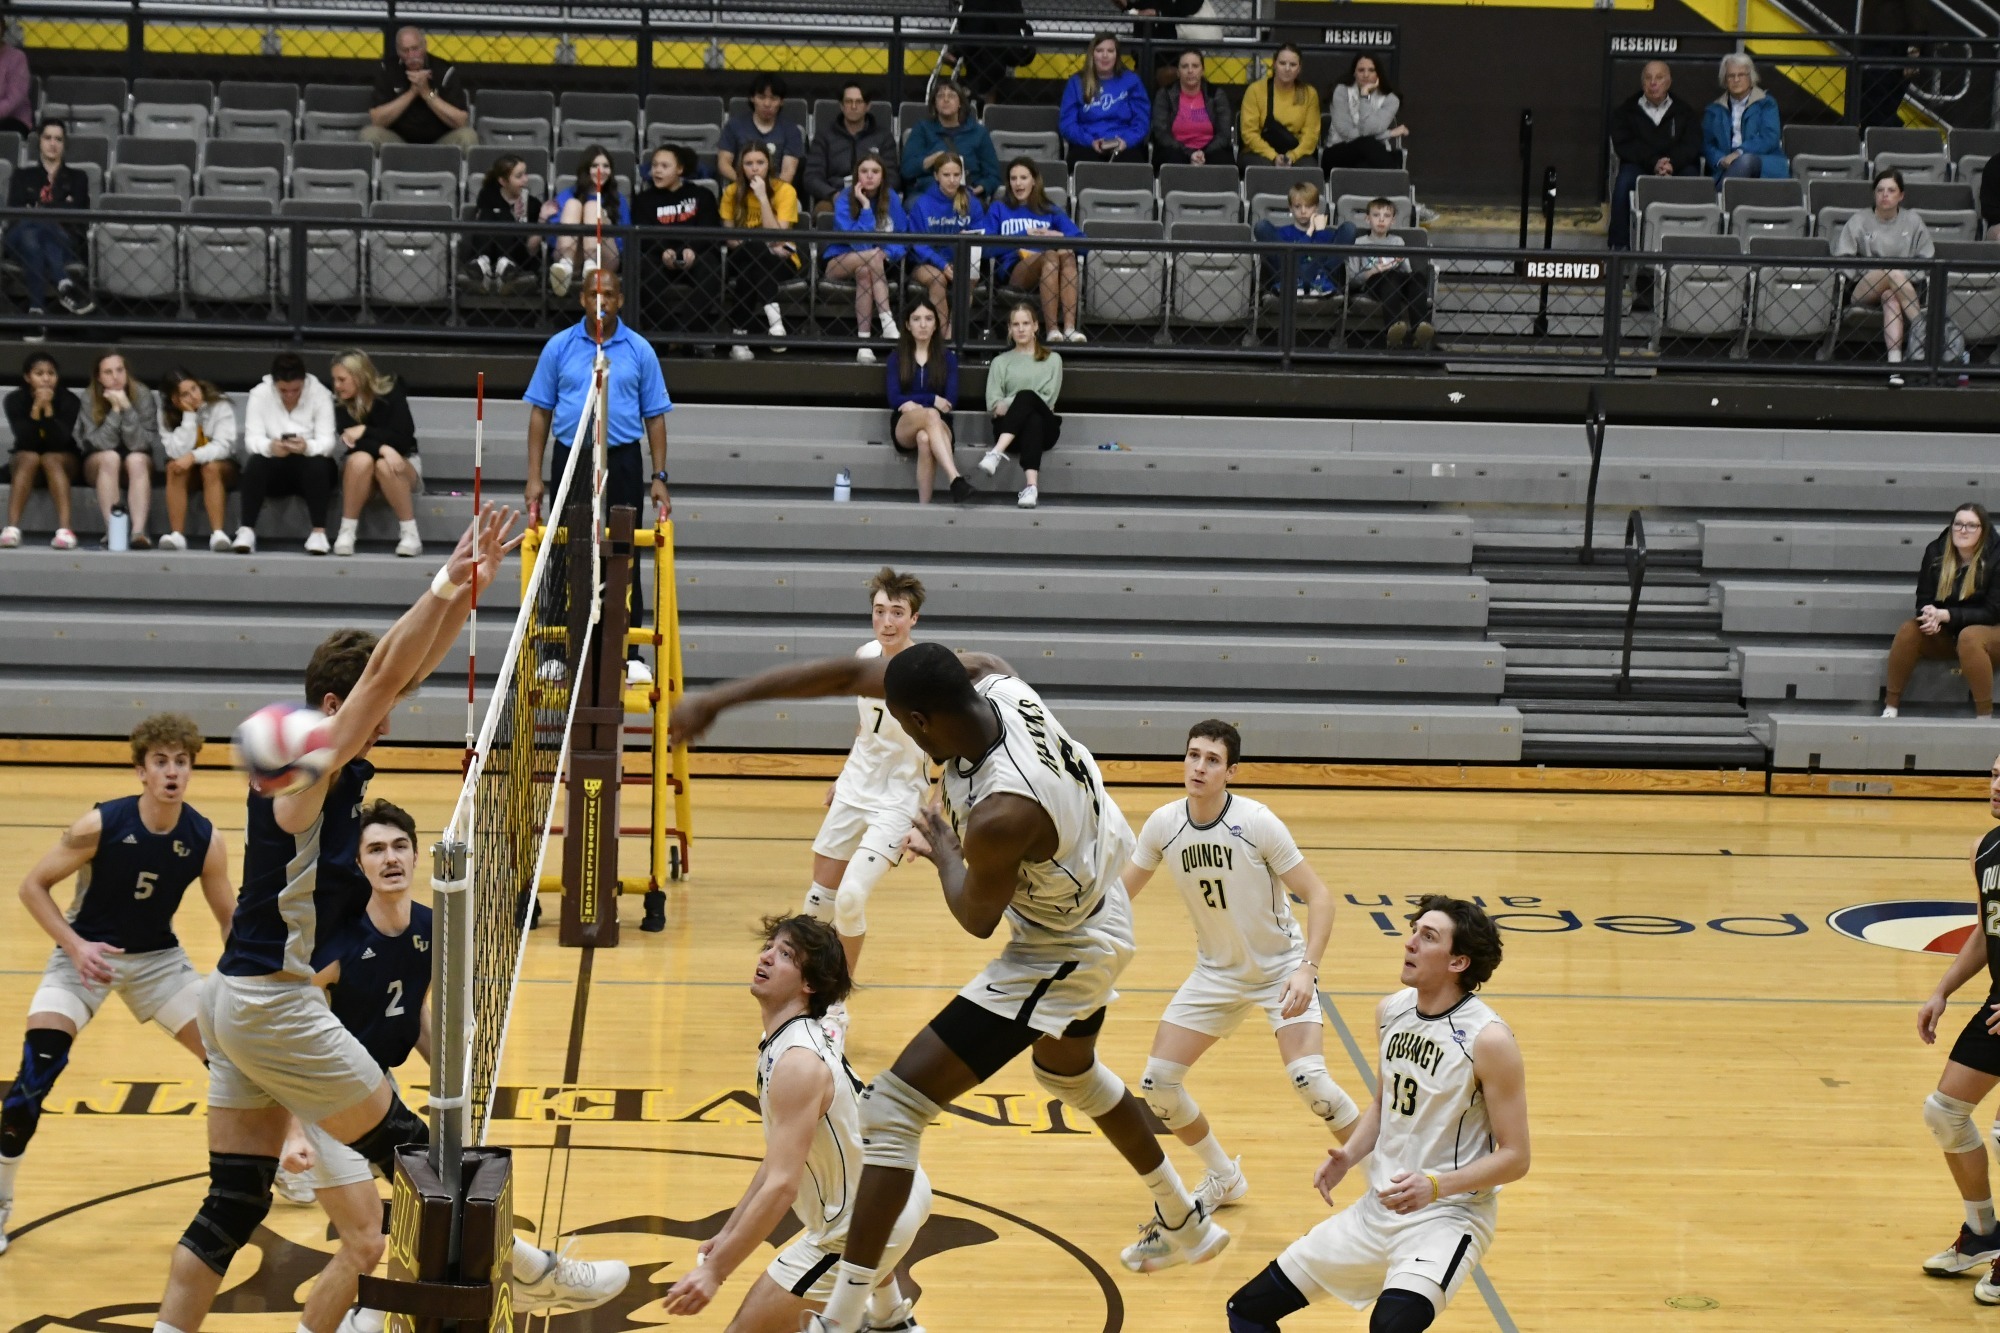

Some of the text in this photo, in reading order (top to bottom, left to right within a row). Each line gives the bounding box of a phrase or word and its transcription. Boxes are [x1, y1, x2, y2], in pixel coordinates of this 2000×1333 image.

[1325, 29, 1392, 45] RESERVED
[1611, 36, 1678, 53] RESERVED
[1527, 261, 1600, 279] RESERVED
[873, 706, 884, 734] 7
[1181, 843, 1233, 874] QUINCY
[134, 871, 159, 900] 5
[1199, 879, 1227, 910] 21
[1368, 909, 1810, 938] pepi
[385, 979, 405, 1018] 2
[1385, 1032, 1445, 1077] QUINCY
[1391, 1072, 1418, 1117] 13
